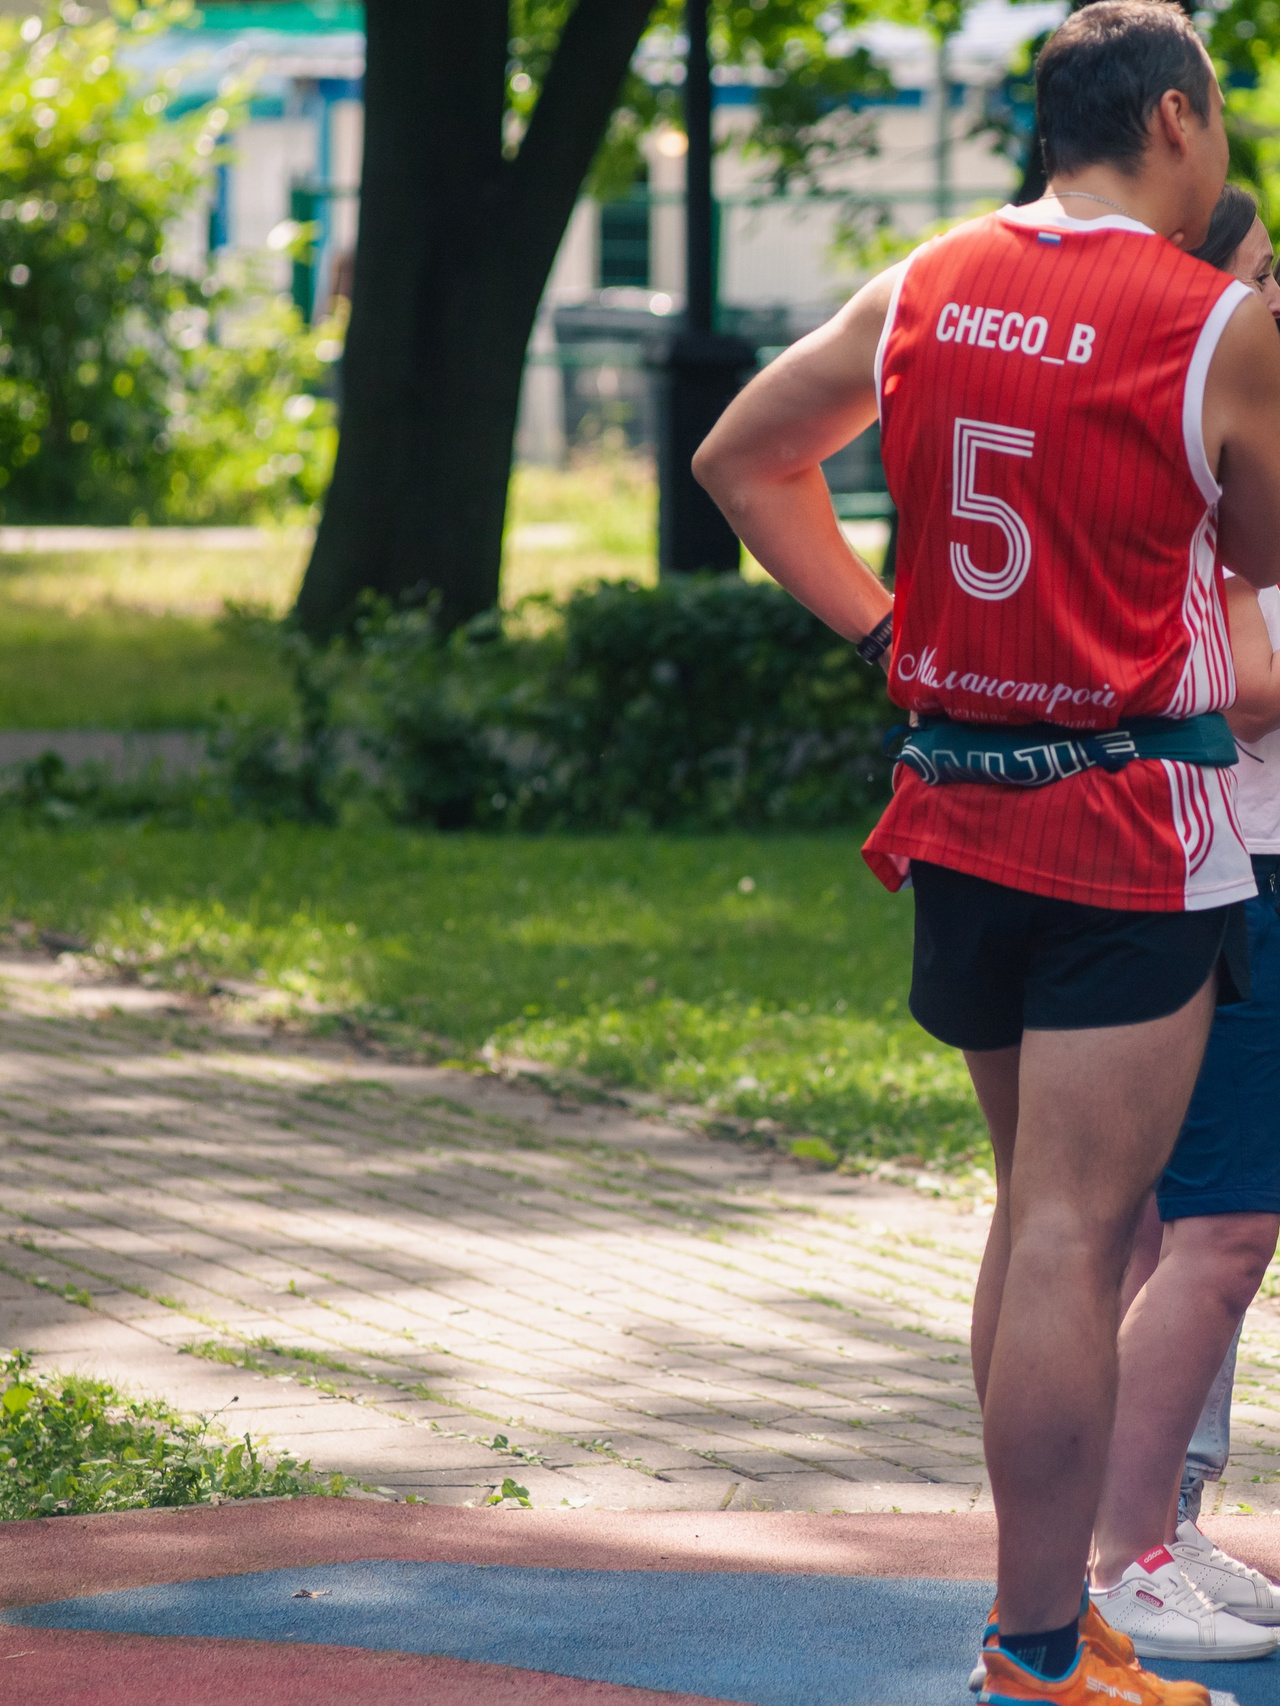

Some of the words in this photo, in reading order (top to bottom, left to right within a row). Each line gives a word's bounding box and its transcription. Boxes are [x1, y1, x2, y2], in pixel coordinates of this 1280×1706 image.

[935, 302, 1097, 364] CHECO_B
[949, 417, 1036, 601] 5
[897, 645, 1119, 714] Миланстрой
[1143, 1549, 1164, 1564] adidas
[1138, 1592, 1161, 1608] adidas
